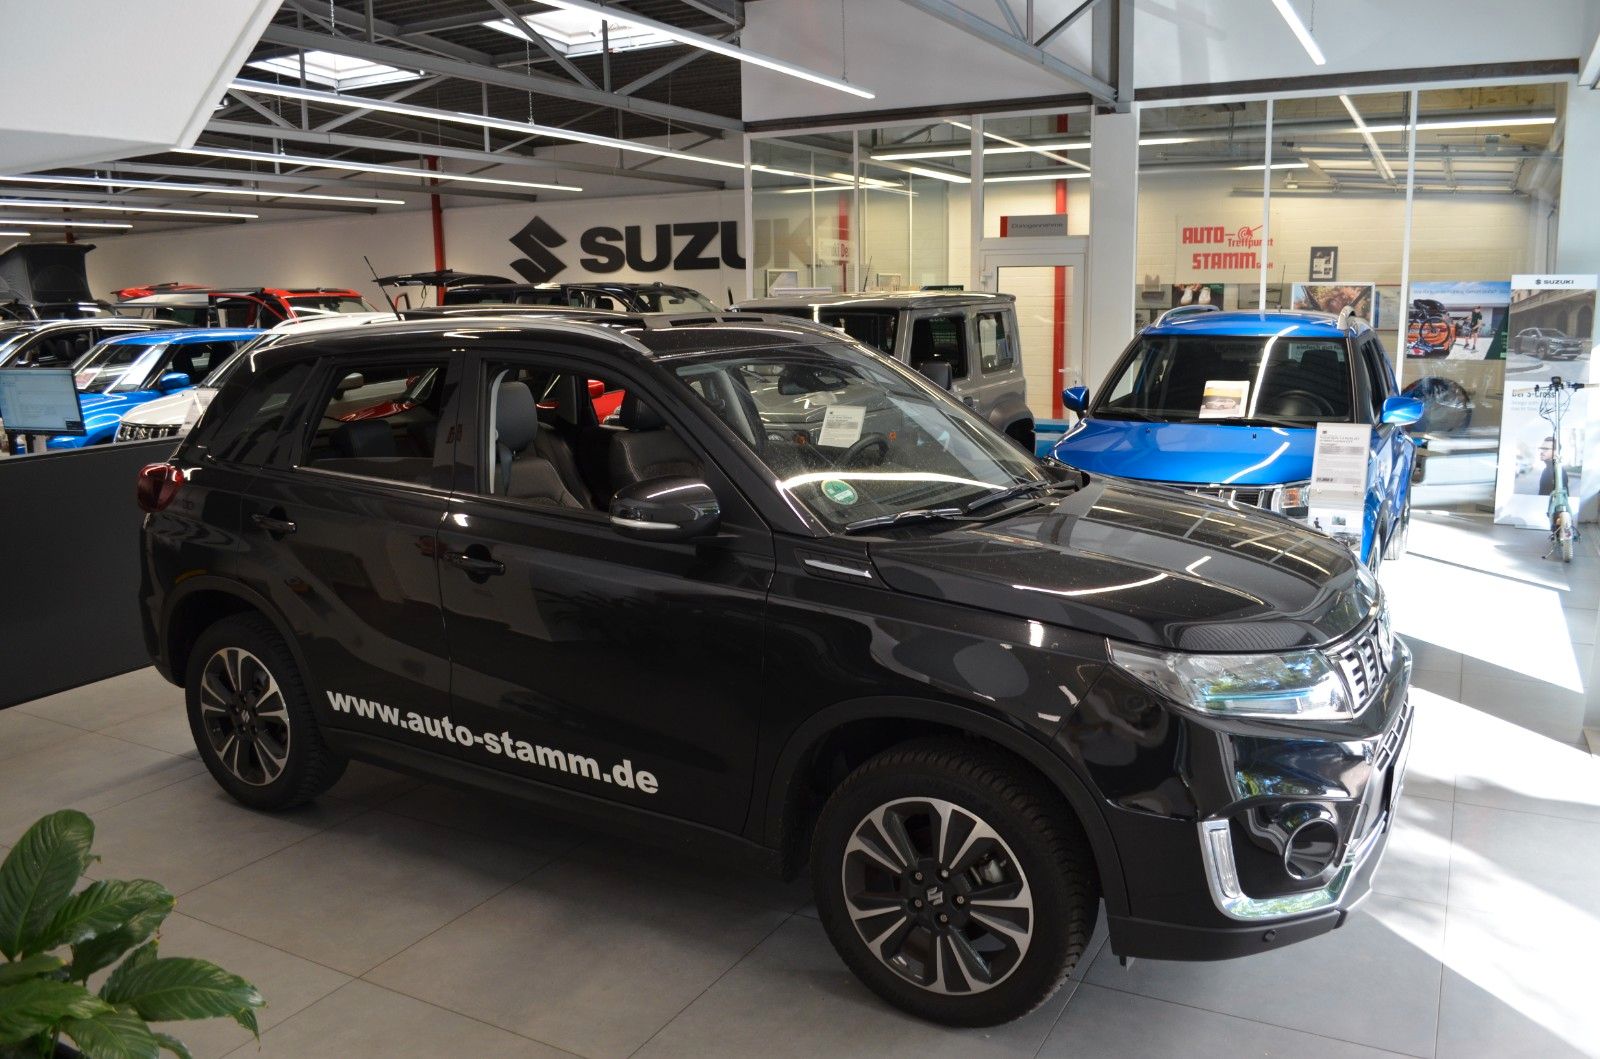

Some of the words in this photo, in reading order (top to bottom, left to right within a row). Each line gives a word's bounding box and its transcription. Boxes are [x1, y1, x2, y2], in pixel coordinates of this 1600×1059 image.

[1227, 238, 1274, 249] Treffput
[1192, 252, 1256, 269] STAMM
[326, 690, 659, 794] www.auto-stamm.de
